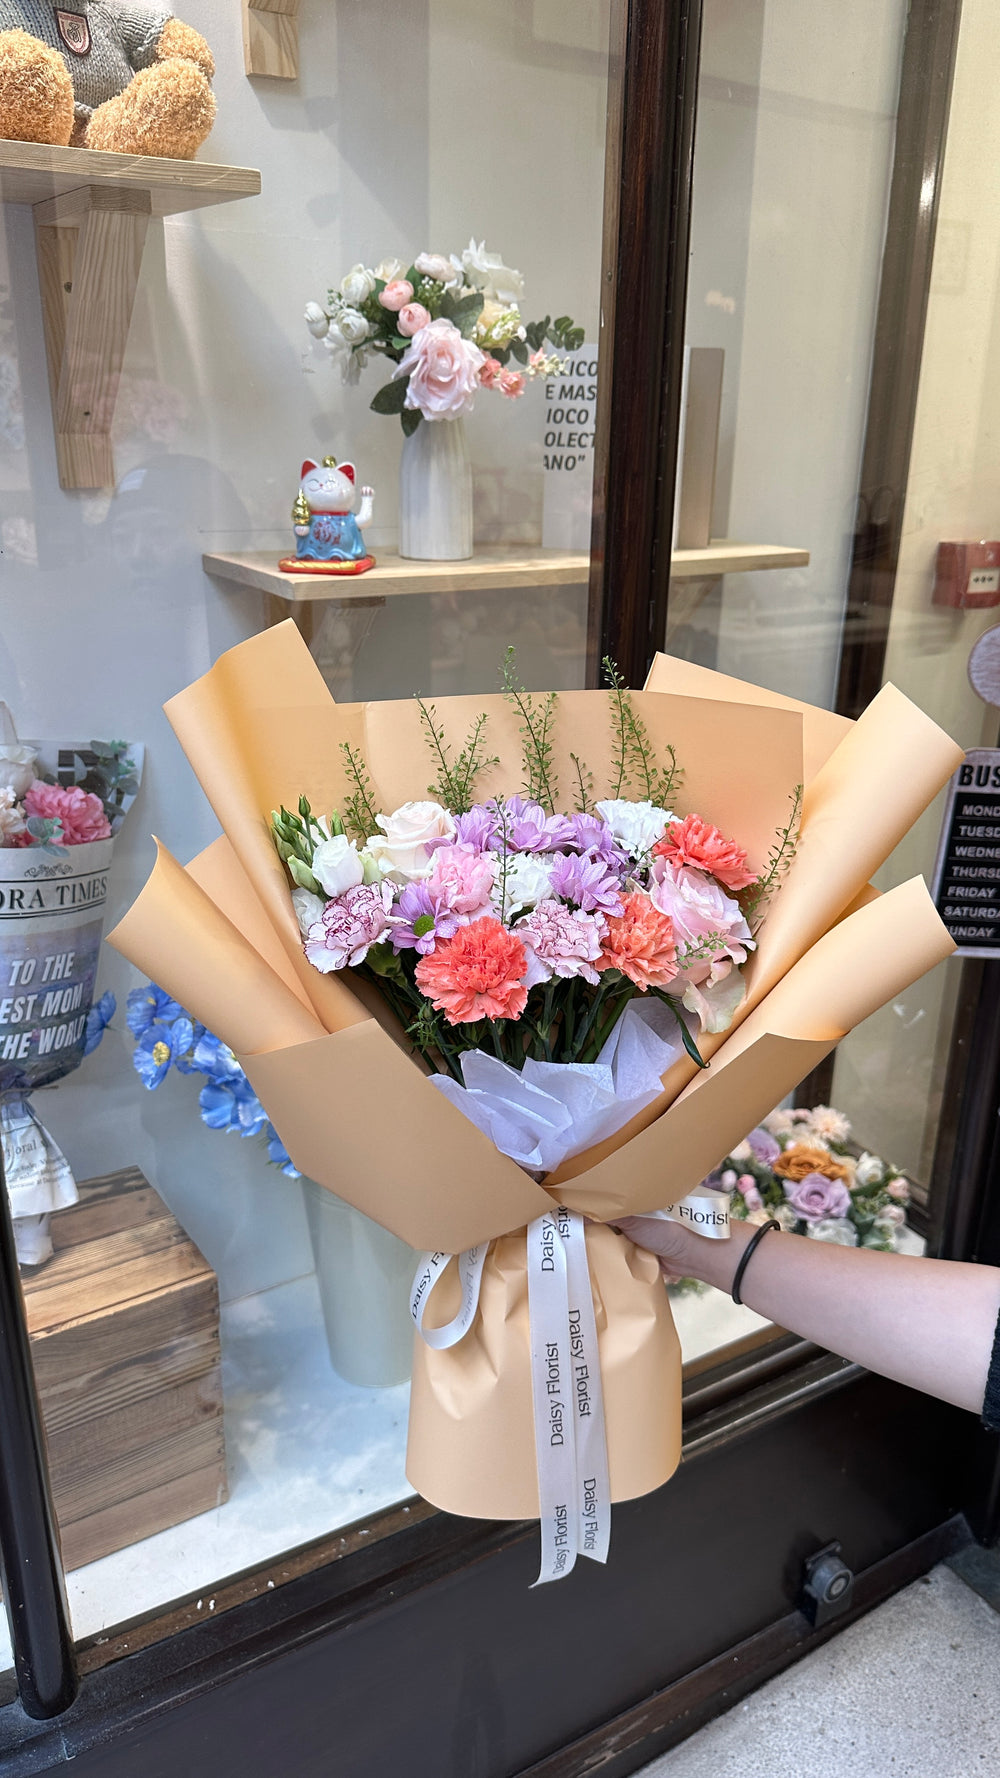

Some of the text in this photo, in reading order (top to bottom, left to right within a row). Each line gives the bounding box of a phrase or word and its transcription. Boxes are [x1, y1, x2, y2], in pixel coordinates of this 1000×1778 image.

[545, 384, 598, 401] E MAS
[958, 764, 1000, 788] BUS
[56, 876, 108, 905] TIMES
[947, 886, 997, 898] FRIDAY
[946, 925, 995, 938] UNDAY
[9, 952, 75, 987] TO THE
[0, 983, 84, 1024] EST MOM
[38, 1014, 86, 1055] WORLD
[679, 1205, 728, 1225] Florist
[540, 1219, 557, 1272] Daisy
[412, 1268, 431, 1319] Daisy
[568, 1309, 592, 1418] Daisy Florist
[545, 1342, 565, 1447] Daisy Florist
[582, 1477, 598, 1518] Daisy
[553, 1504, 568, 1547] Florist
